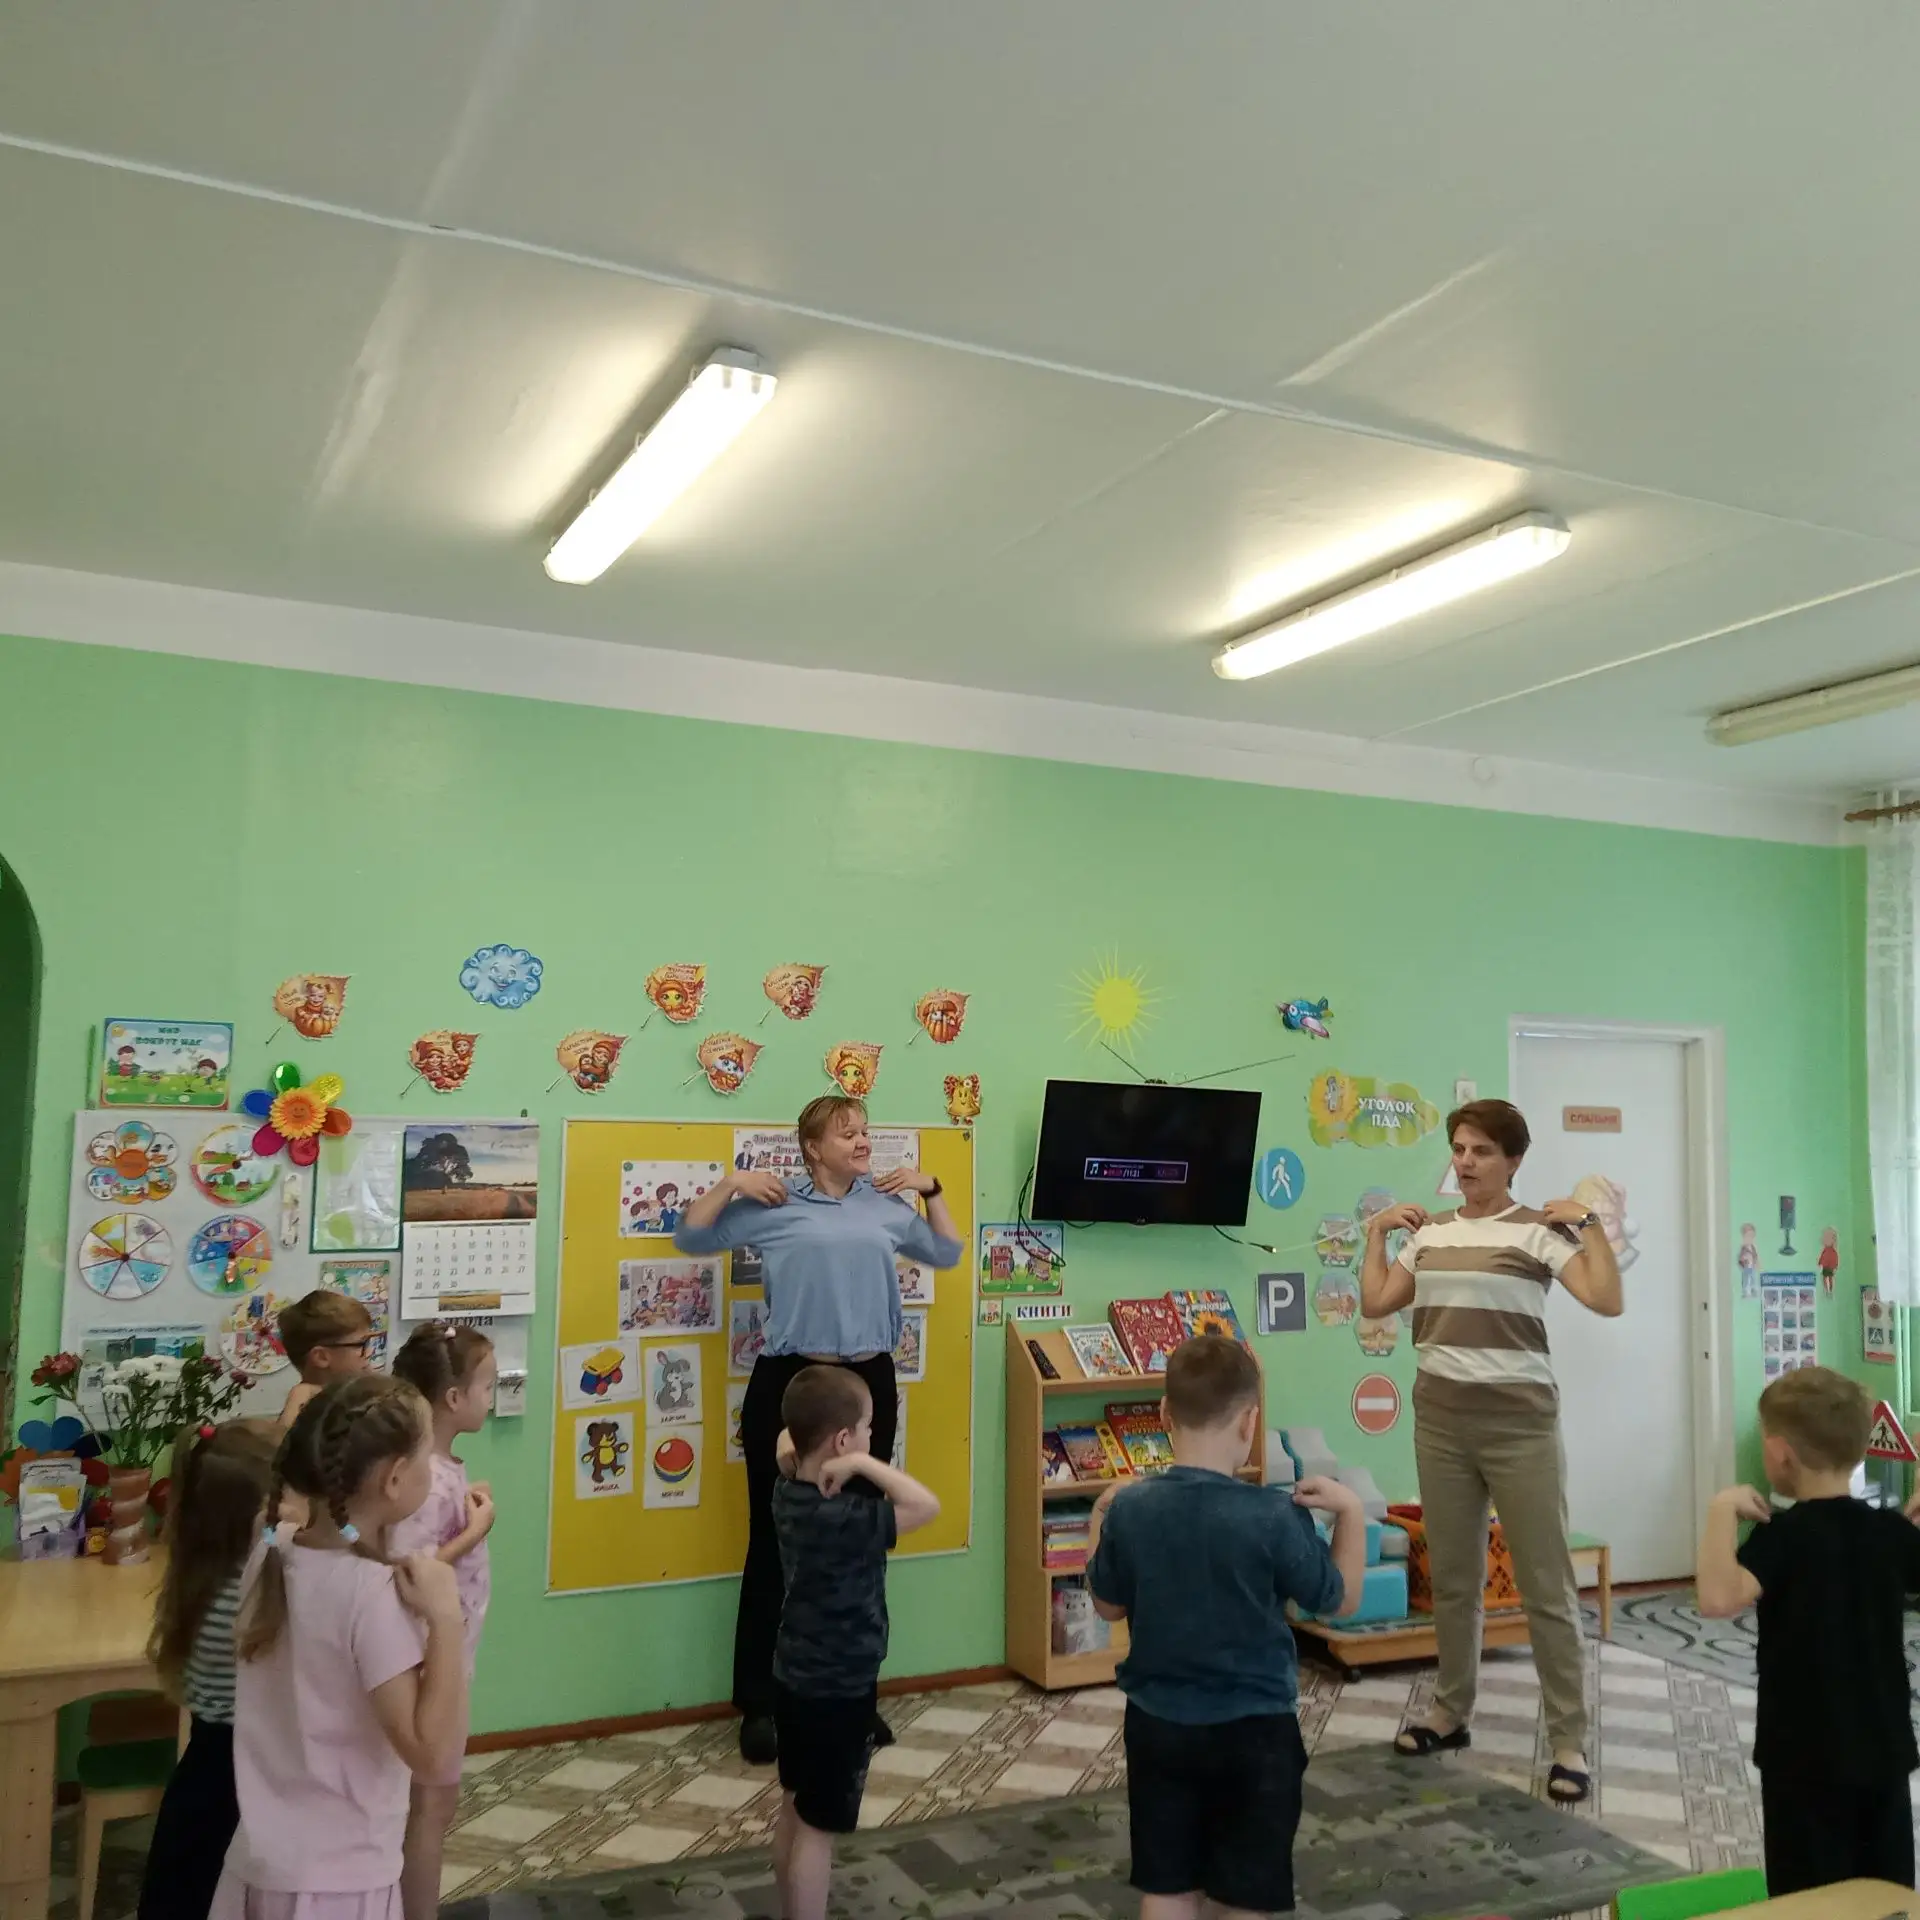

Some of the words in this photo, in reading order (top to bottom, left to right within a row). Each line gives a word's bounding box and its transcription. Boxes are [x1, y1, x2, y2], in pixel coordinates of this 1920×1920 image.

[1358, 1097, 1416, 1114] УГОЛОК
[1372, 1113, 1402, 1128] ПДД
[1268, 1280, 1294, 1325] P
[1017, 1305, 1071, 1318] КНИГИ
